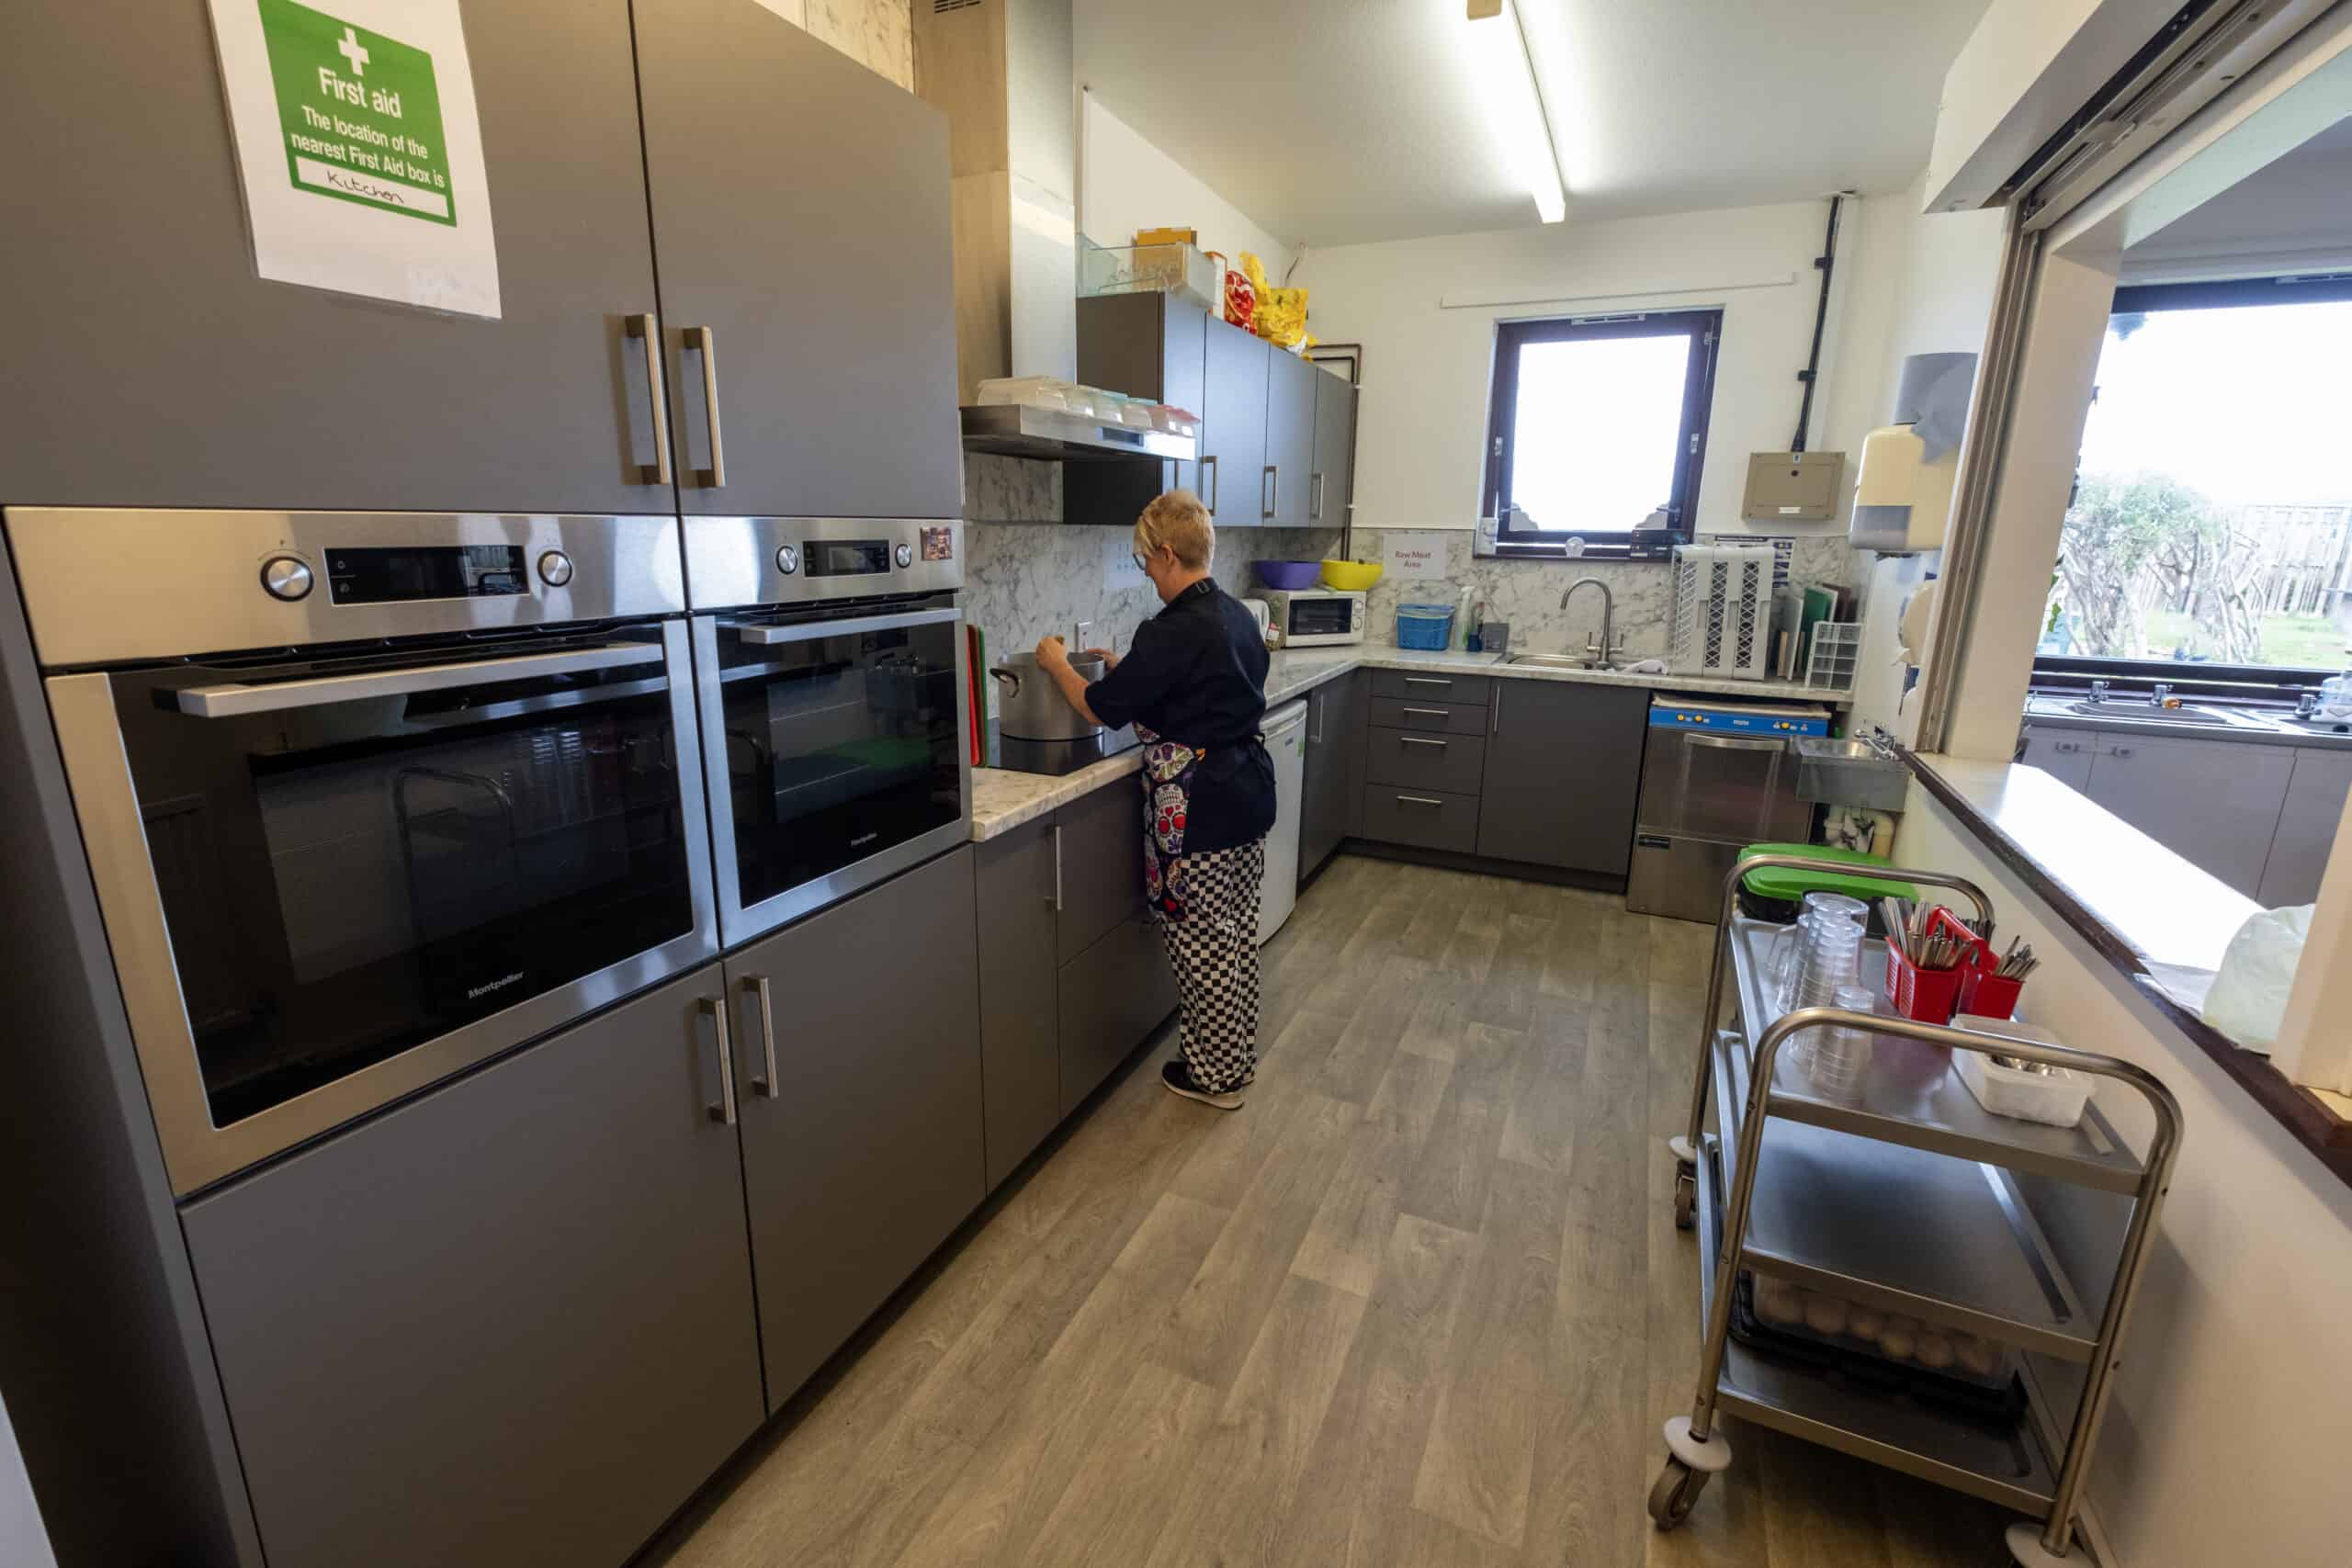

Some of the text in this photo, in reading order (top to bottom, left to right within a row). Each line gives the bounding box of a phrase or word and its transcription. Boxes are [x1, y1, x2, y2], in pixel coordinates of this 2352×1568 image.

[318, 65, 402, 119] First aid
[301, 104, 428, 159] The location of the
[290, 132, 446, 188] nearest First Aid box is
[326, 170, 405, 204] Kitchen
